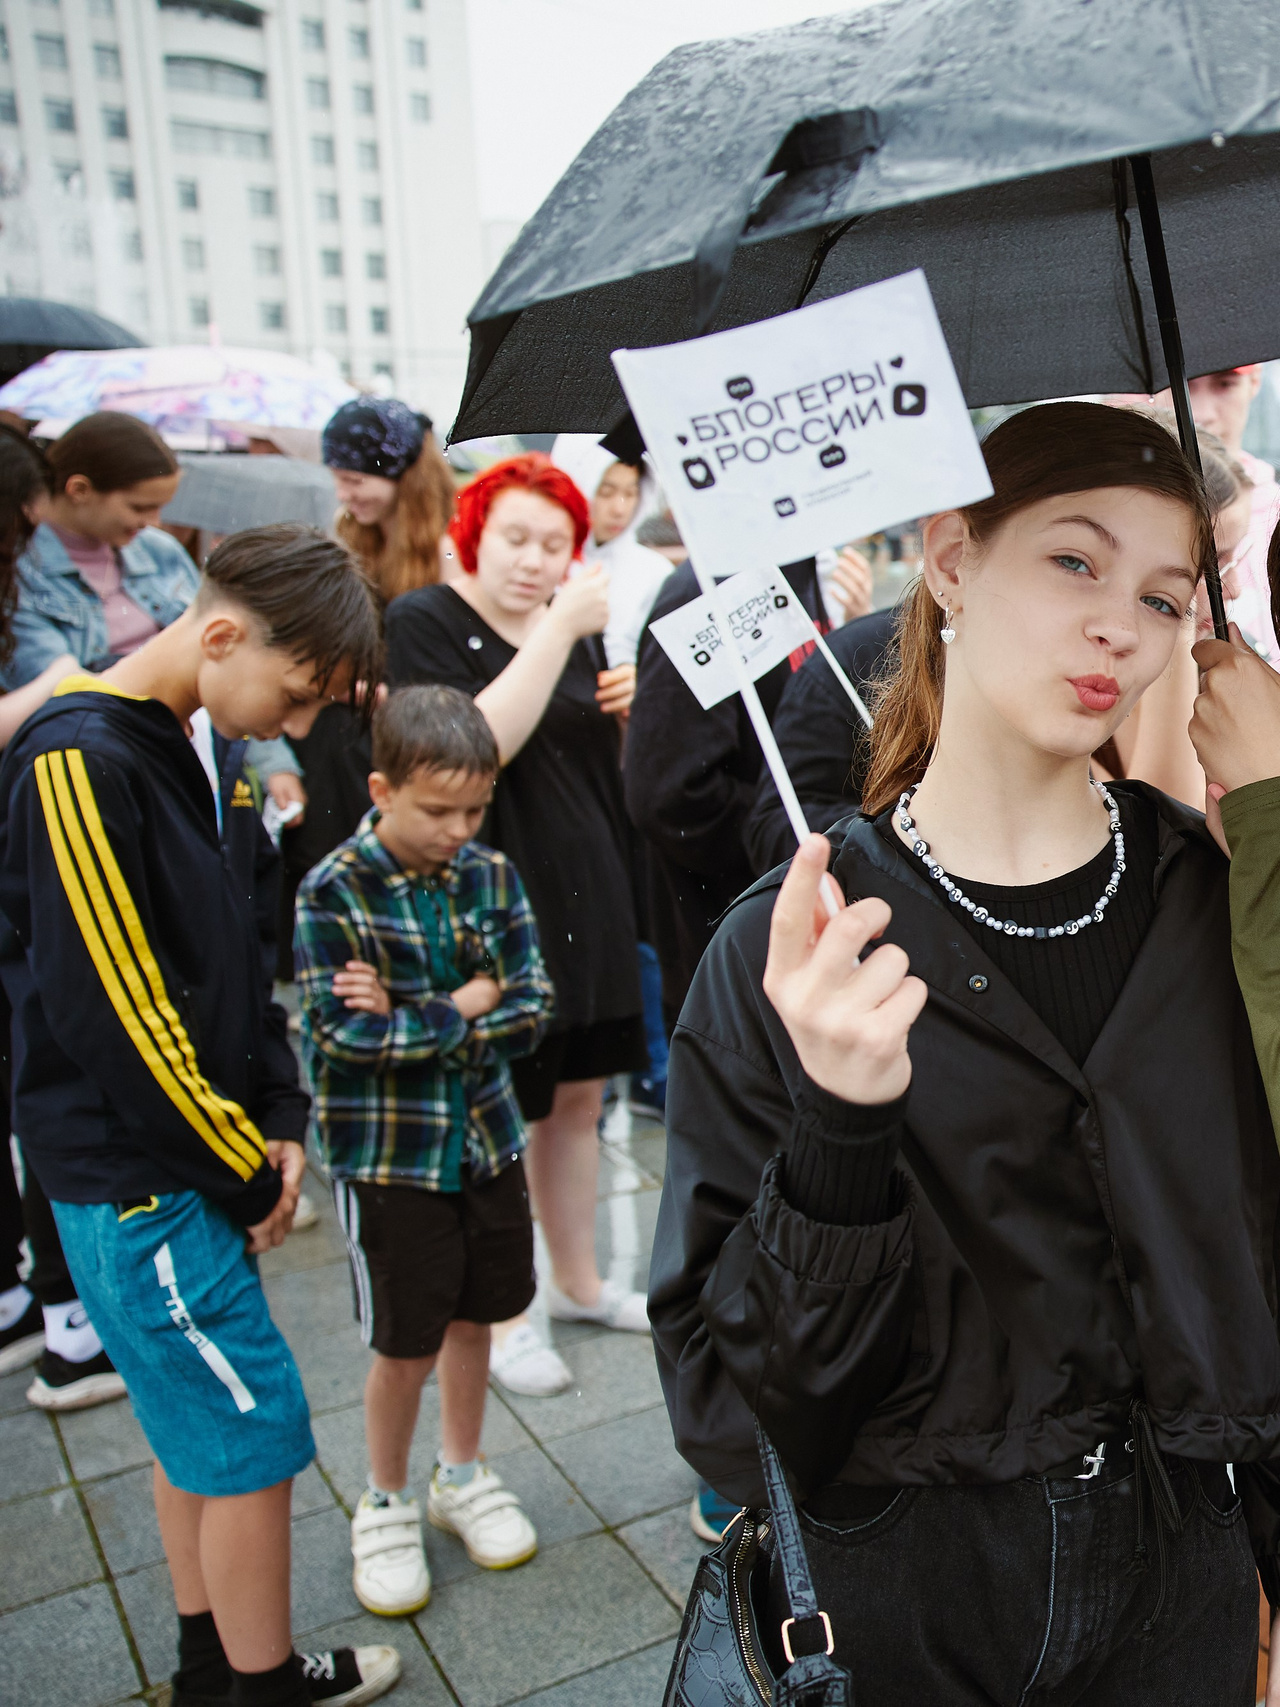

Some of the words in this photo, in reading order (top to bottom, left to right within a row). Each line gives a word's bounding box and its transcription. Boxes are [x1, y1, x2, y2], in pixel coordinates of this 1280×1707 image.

[690, 361, 886, 442] БЛОГЕРЫ
[715, 397, 885, 471] РОССИИ
[695, 589, 771, 644] БЛГЕРЫ
[707, 604, 774, 653] РССИИ
